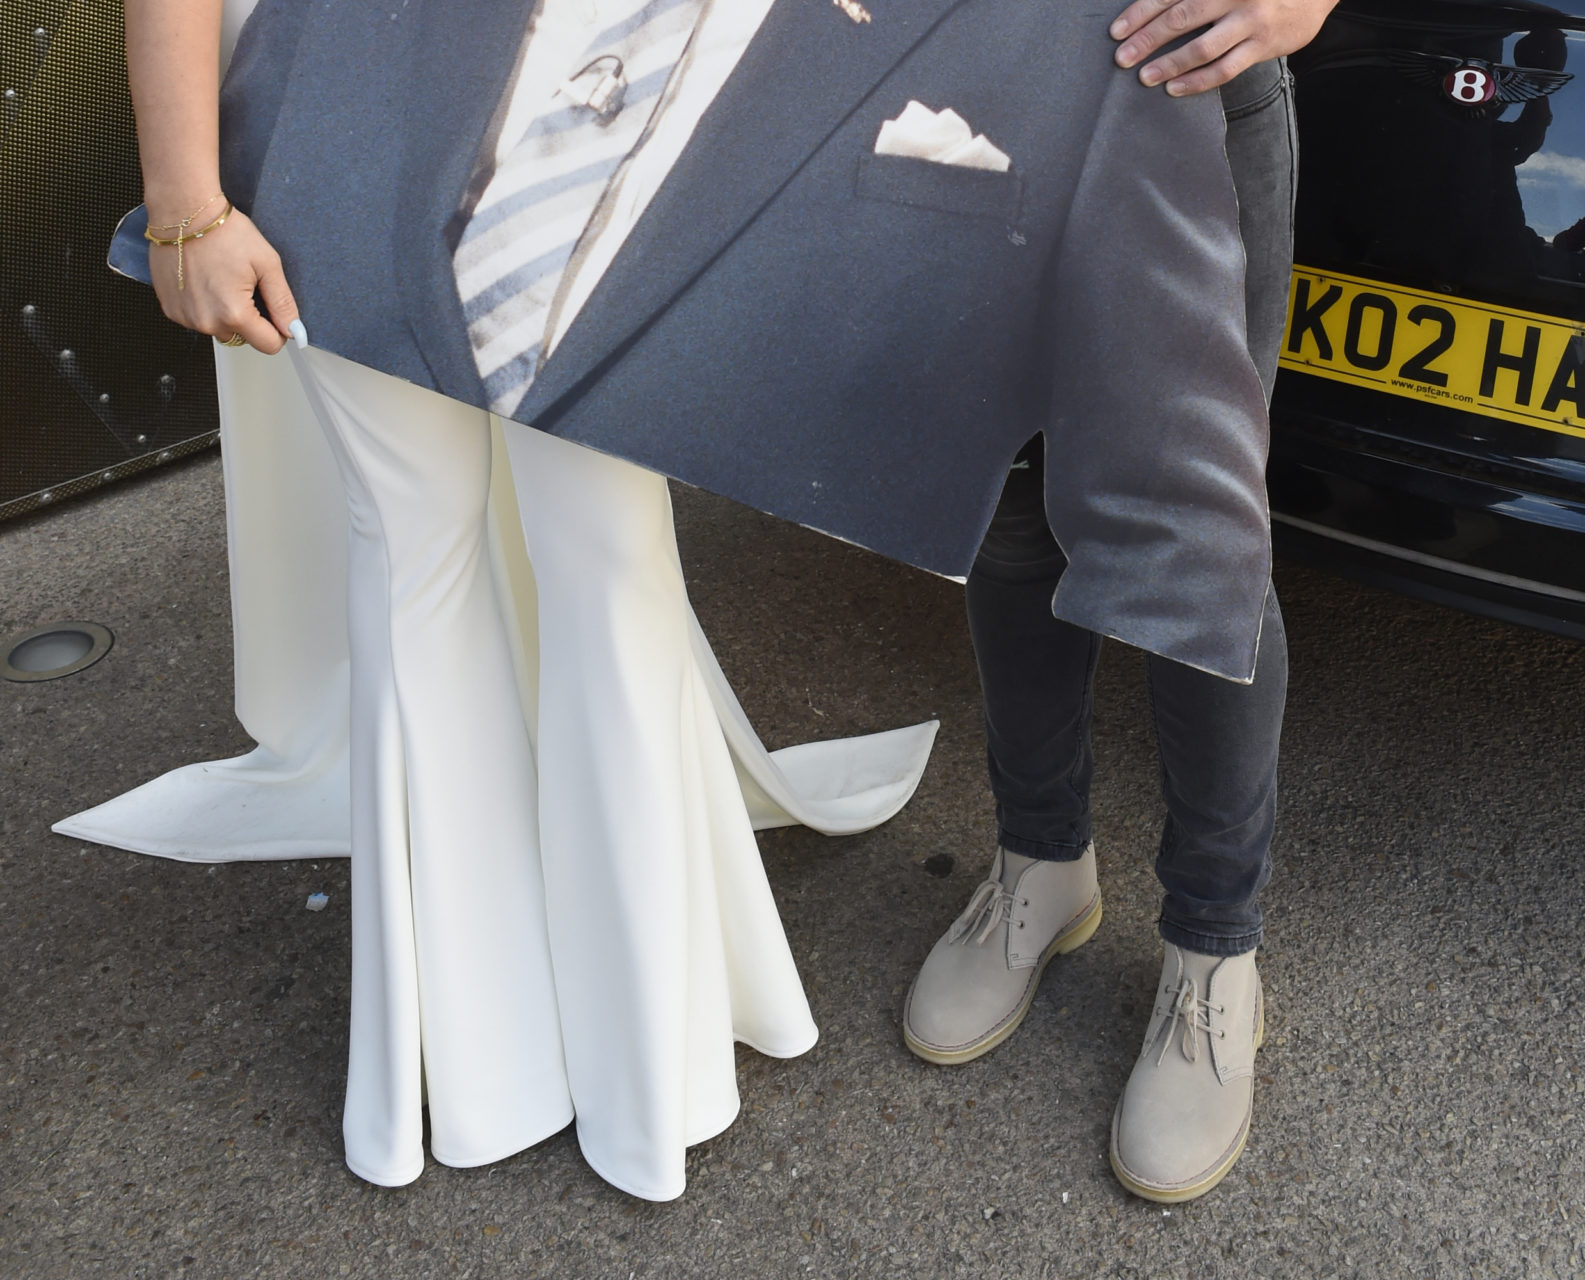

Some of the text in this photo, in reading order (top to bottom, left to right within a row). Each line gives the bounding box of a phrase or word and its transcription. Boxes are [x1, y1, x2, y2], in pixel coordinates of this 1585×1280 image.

[1451, 69, 1488, 103] B
[1478, 317, 1585, 420] HA
[1390, 378, 1474, 404] www.psfcars.com
